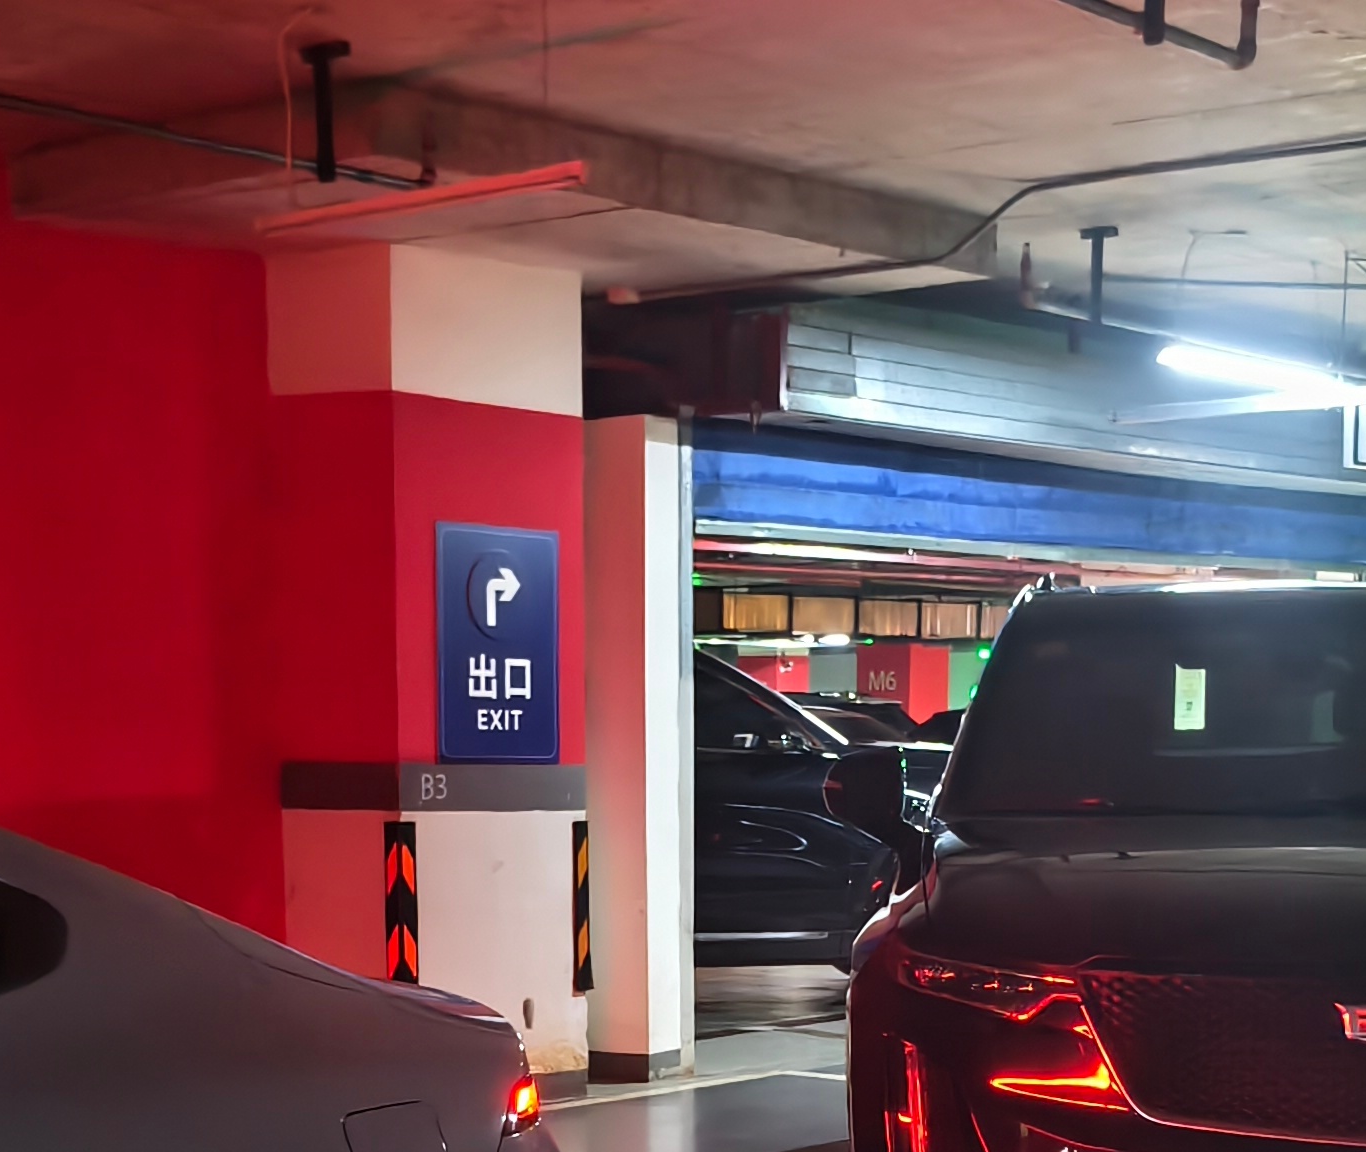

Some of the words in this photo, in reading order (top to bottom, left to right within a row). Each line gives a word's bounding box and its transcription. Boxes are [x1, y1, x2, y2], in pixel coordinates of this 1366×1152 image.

[469, 653, 531, 699] 出口
[869, 671, 896, 691] M6
[477, 709, 523, 730] EXIT
[421, 774, 447, 800] B3
